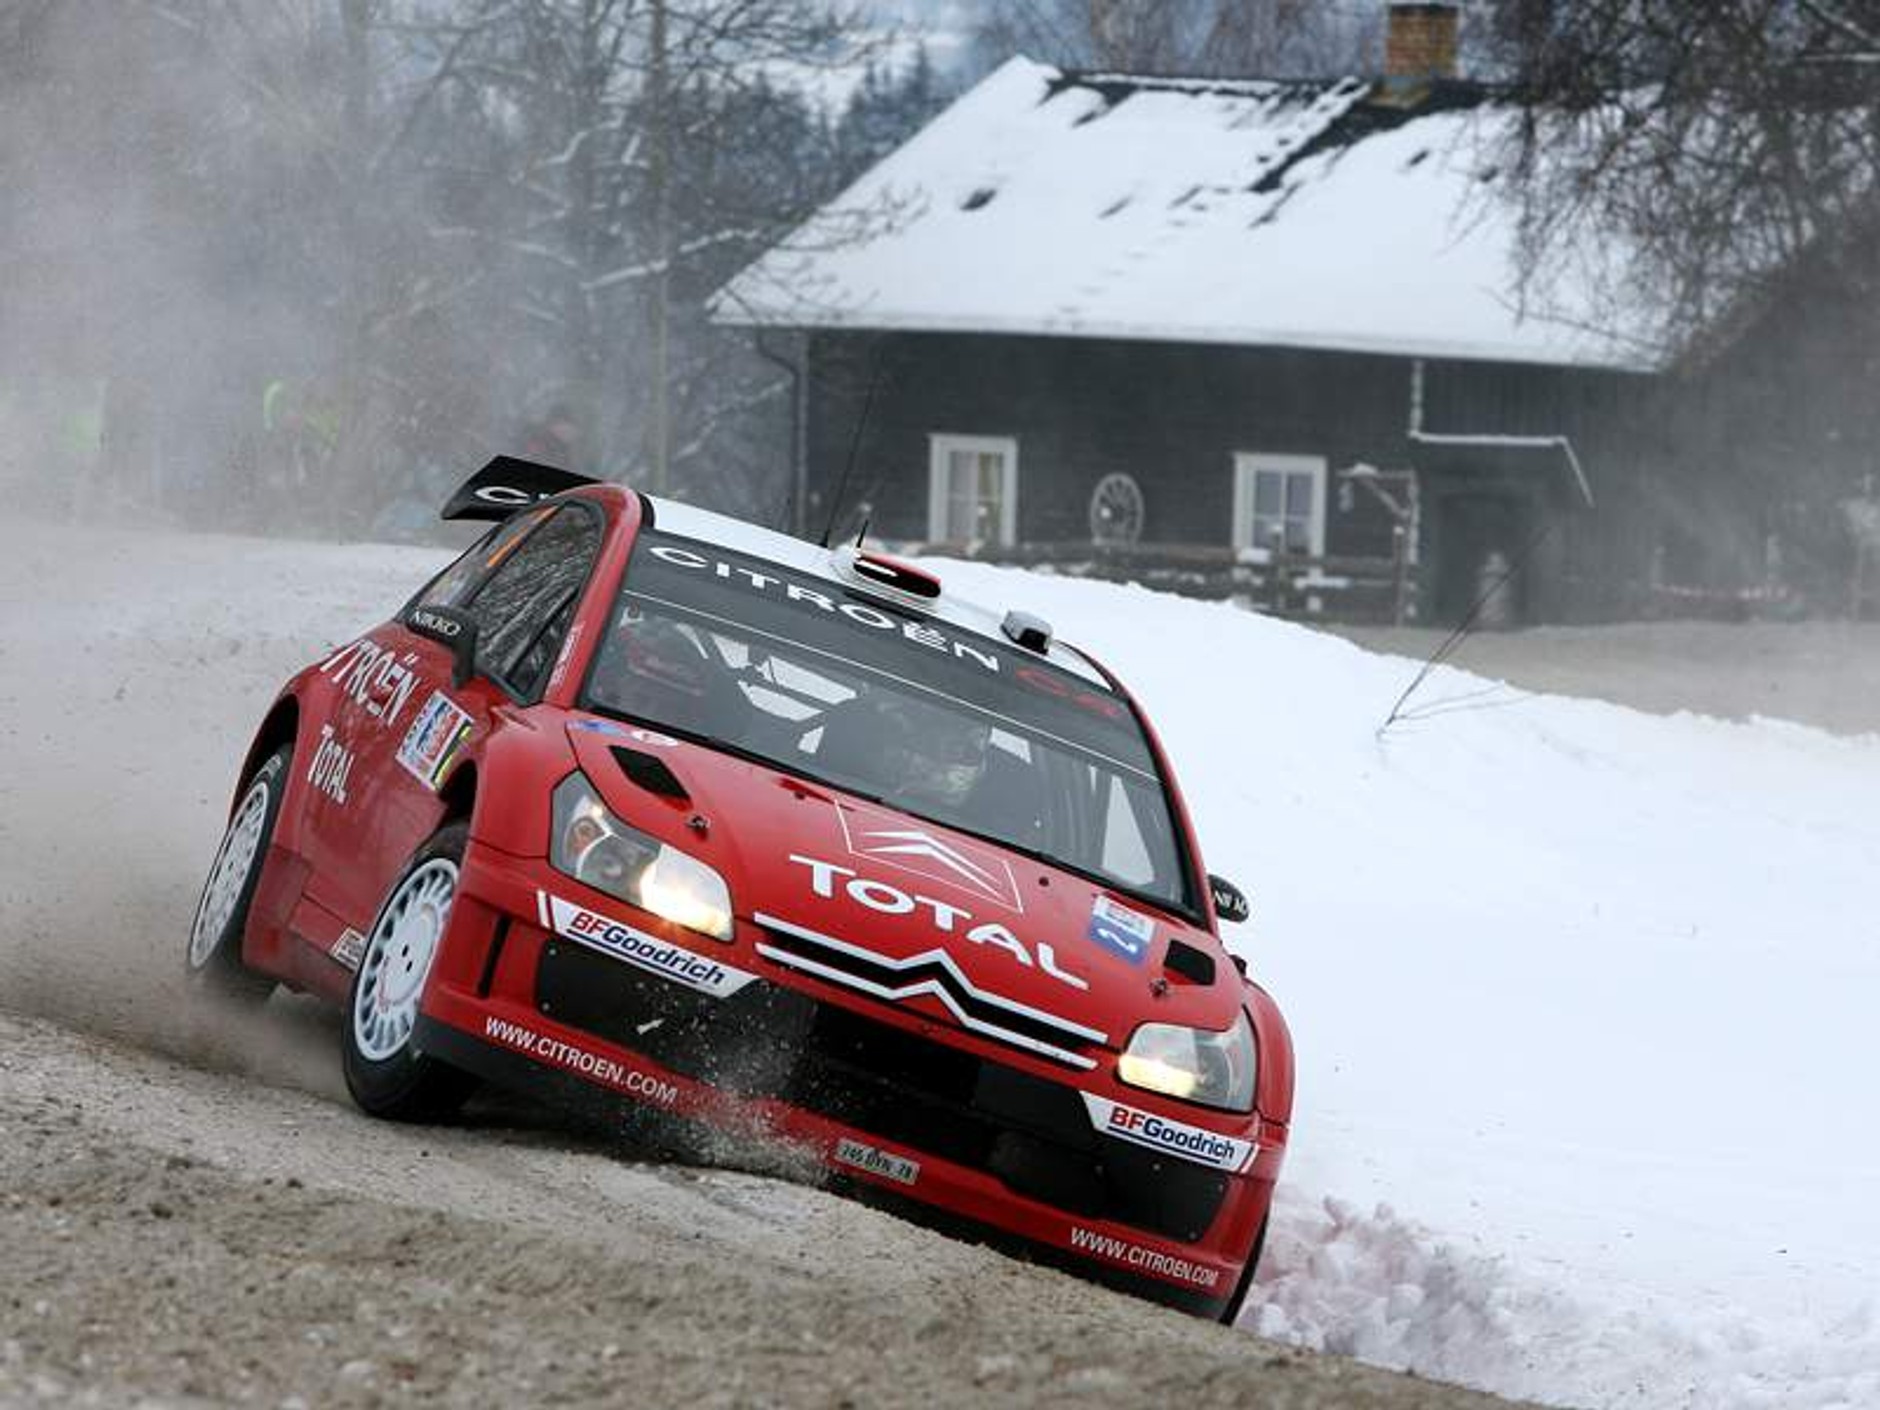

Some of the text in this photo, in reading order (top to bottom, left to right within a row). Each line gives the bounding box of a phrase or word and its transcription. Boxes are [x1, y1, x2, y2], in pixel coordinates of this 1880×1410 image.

[649, 546, 1000, 672] CITROËN
[319, 638, 422, 727] ITROËN
[307, 723, 355, 804] TOTAL
[570, 911, 726, 986] BFGoodrich
[789, 853, 1090, 993] TOTAL
[485, 1015, 679, 1104] WWW.CITROEN.COM
[1109, 1106, 1236, 1160] BFGoodrich
[1070, 1226, 1220, 1287] WWW.CITROEN.COM
